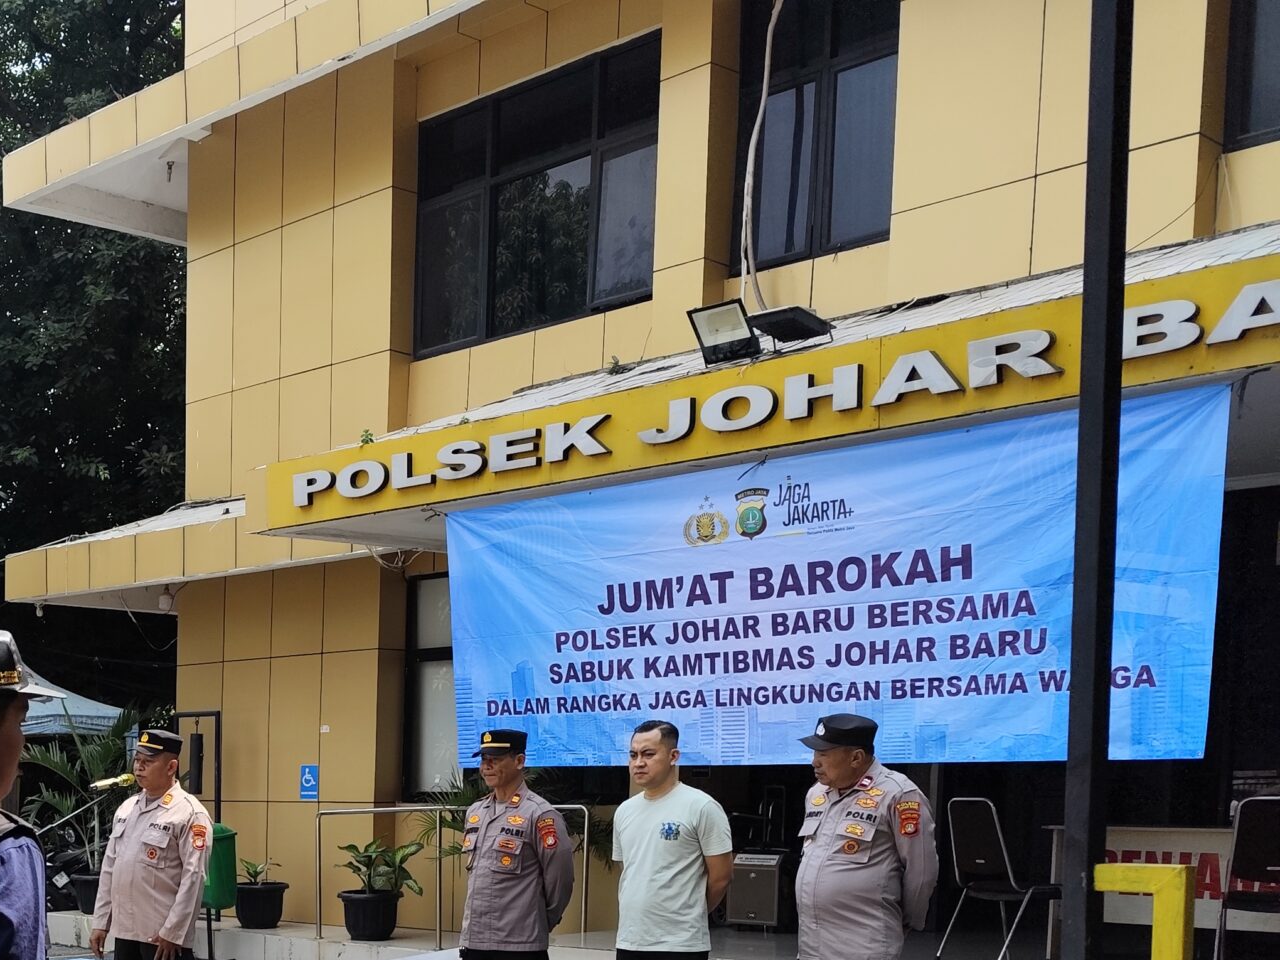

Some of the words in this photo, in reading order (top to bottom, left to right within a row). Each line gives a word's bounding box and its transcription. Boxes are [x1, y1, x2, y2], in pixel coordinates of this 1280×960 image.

[292, 413, 613, 507] POLSEK
[637, 329, 1064, 445] JOHAR
[773, 480, 811, 507] JAGA
[598, 571, 734, 615] JUM'AT
[749, 543, 973, 601] BAROKAH
[555, 624, 657, 653] POLSEK
[665, 615, 760, 645] JOHAR
[771, 606, 854, 637] BARU
[867, 590, 1037, 630] BERSAMA
[549, 658, 635, 684] SABUK
[643, 645, 815, 679] KAMTIBMAS
[826, 636, 937, 668] JOHAR
[949, 628, 1048, 661] BARU
[487, 697, 550, 717] DALAM
[557, 693, 641, 714] RANGKA
[648, 689, 708, 710] JAGA
[715, 680, 880, 708] LINGKUNGAN
[891, 672, 1028, 700] BERSAMA
[1039, 665, 1156, 693] WGA
[148, 822, 171, 832] POLRI
[500, 826, 524, 838] POLRI
[845, 810, 878, 823] POLRI
